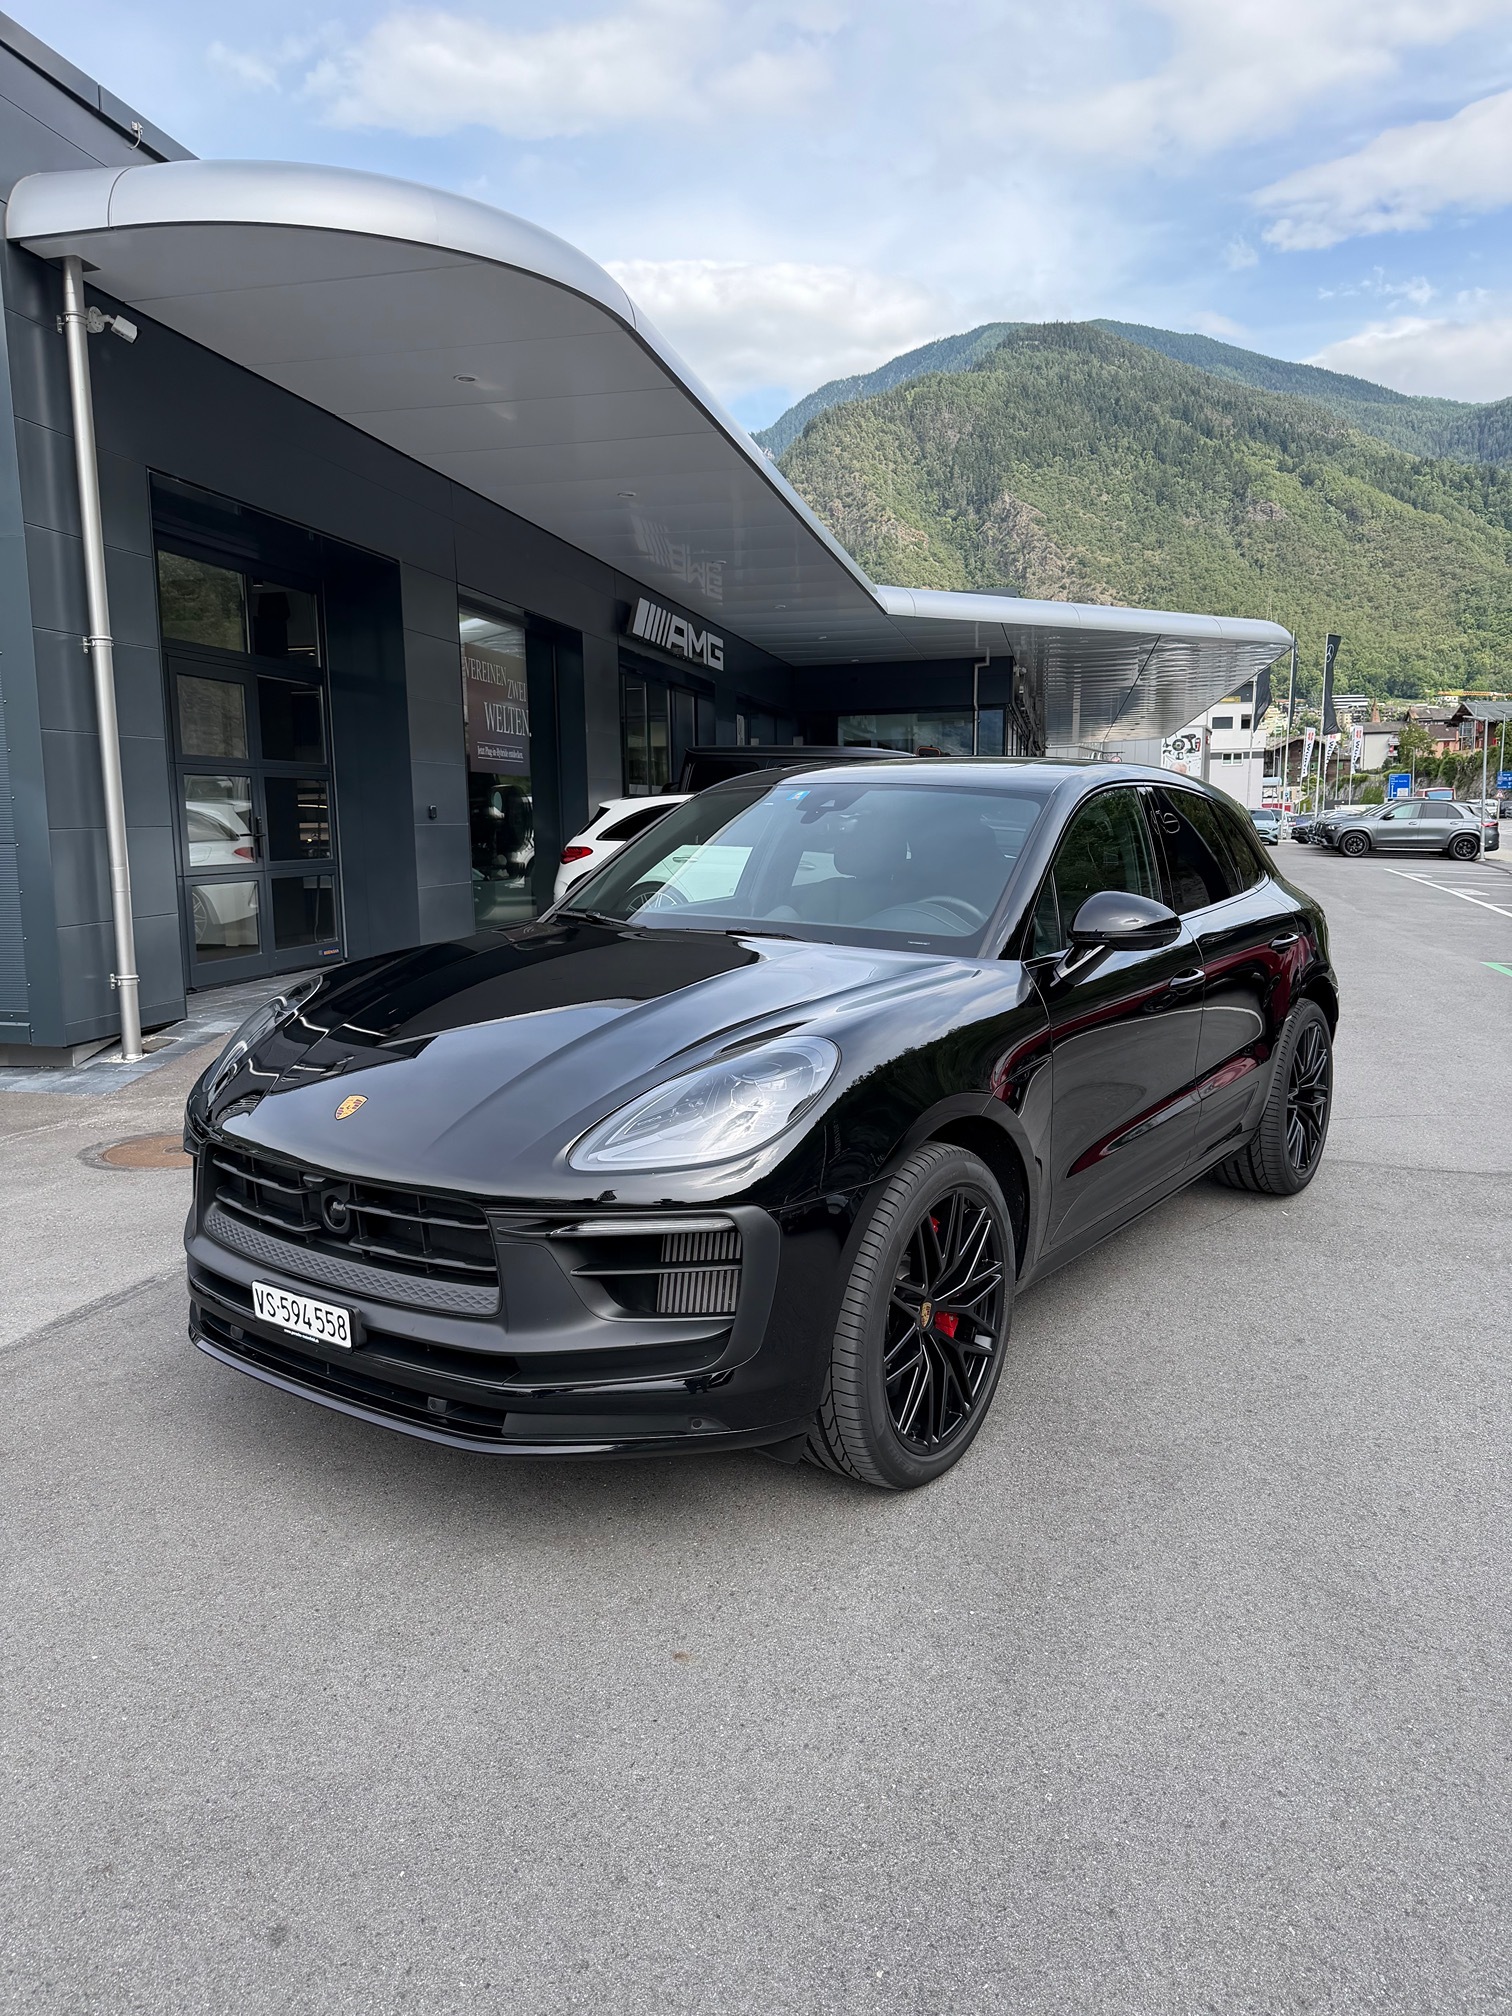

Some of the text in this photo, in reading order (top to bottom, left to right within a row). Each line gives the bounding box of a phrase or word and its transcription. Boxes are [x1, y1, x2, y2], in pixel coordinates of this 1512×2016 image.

[666, 614, 724, 671] AMG
[463, 657, 506, 686] VEREINEN
[507, 679, 527, 702] ZWEI
[483, 702, 532, 737] WELTEN.
